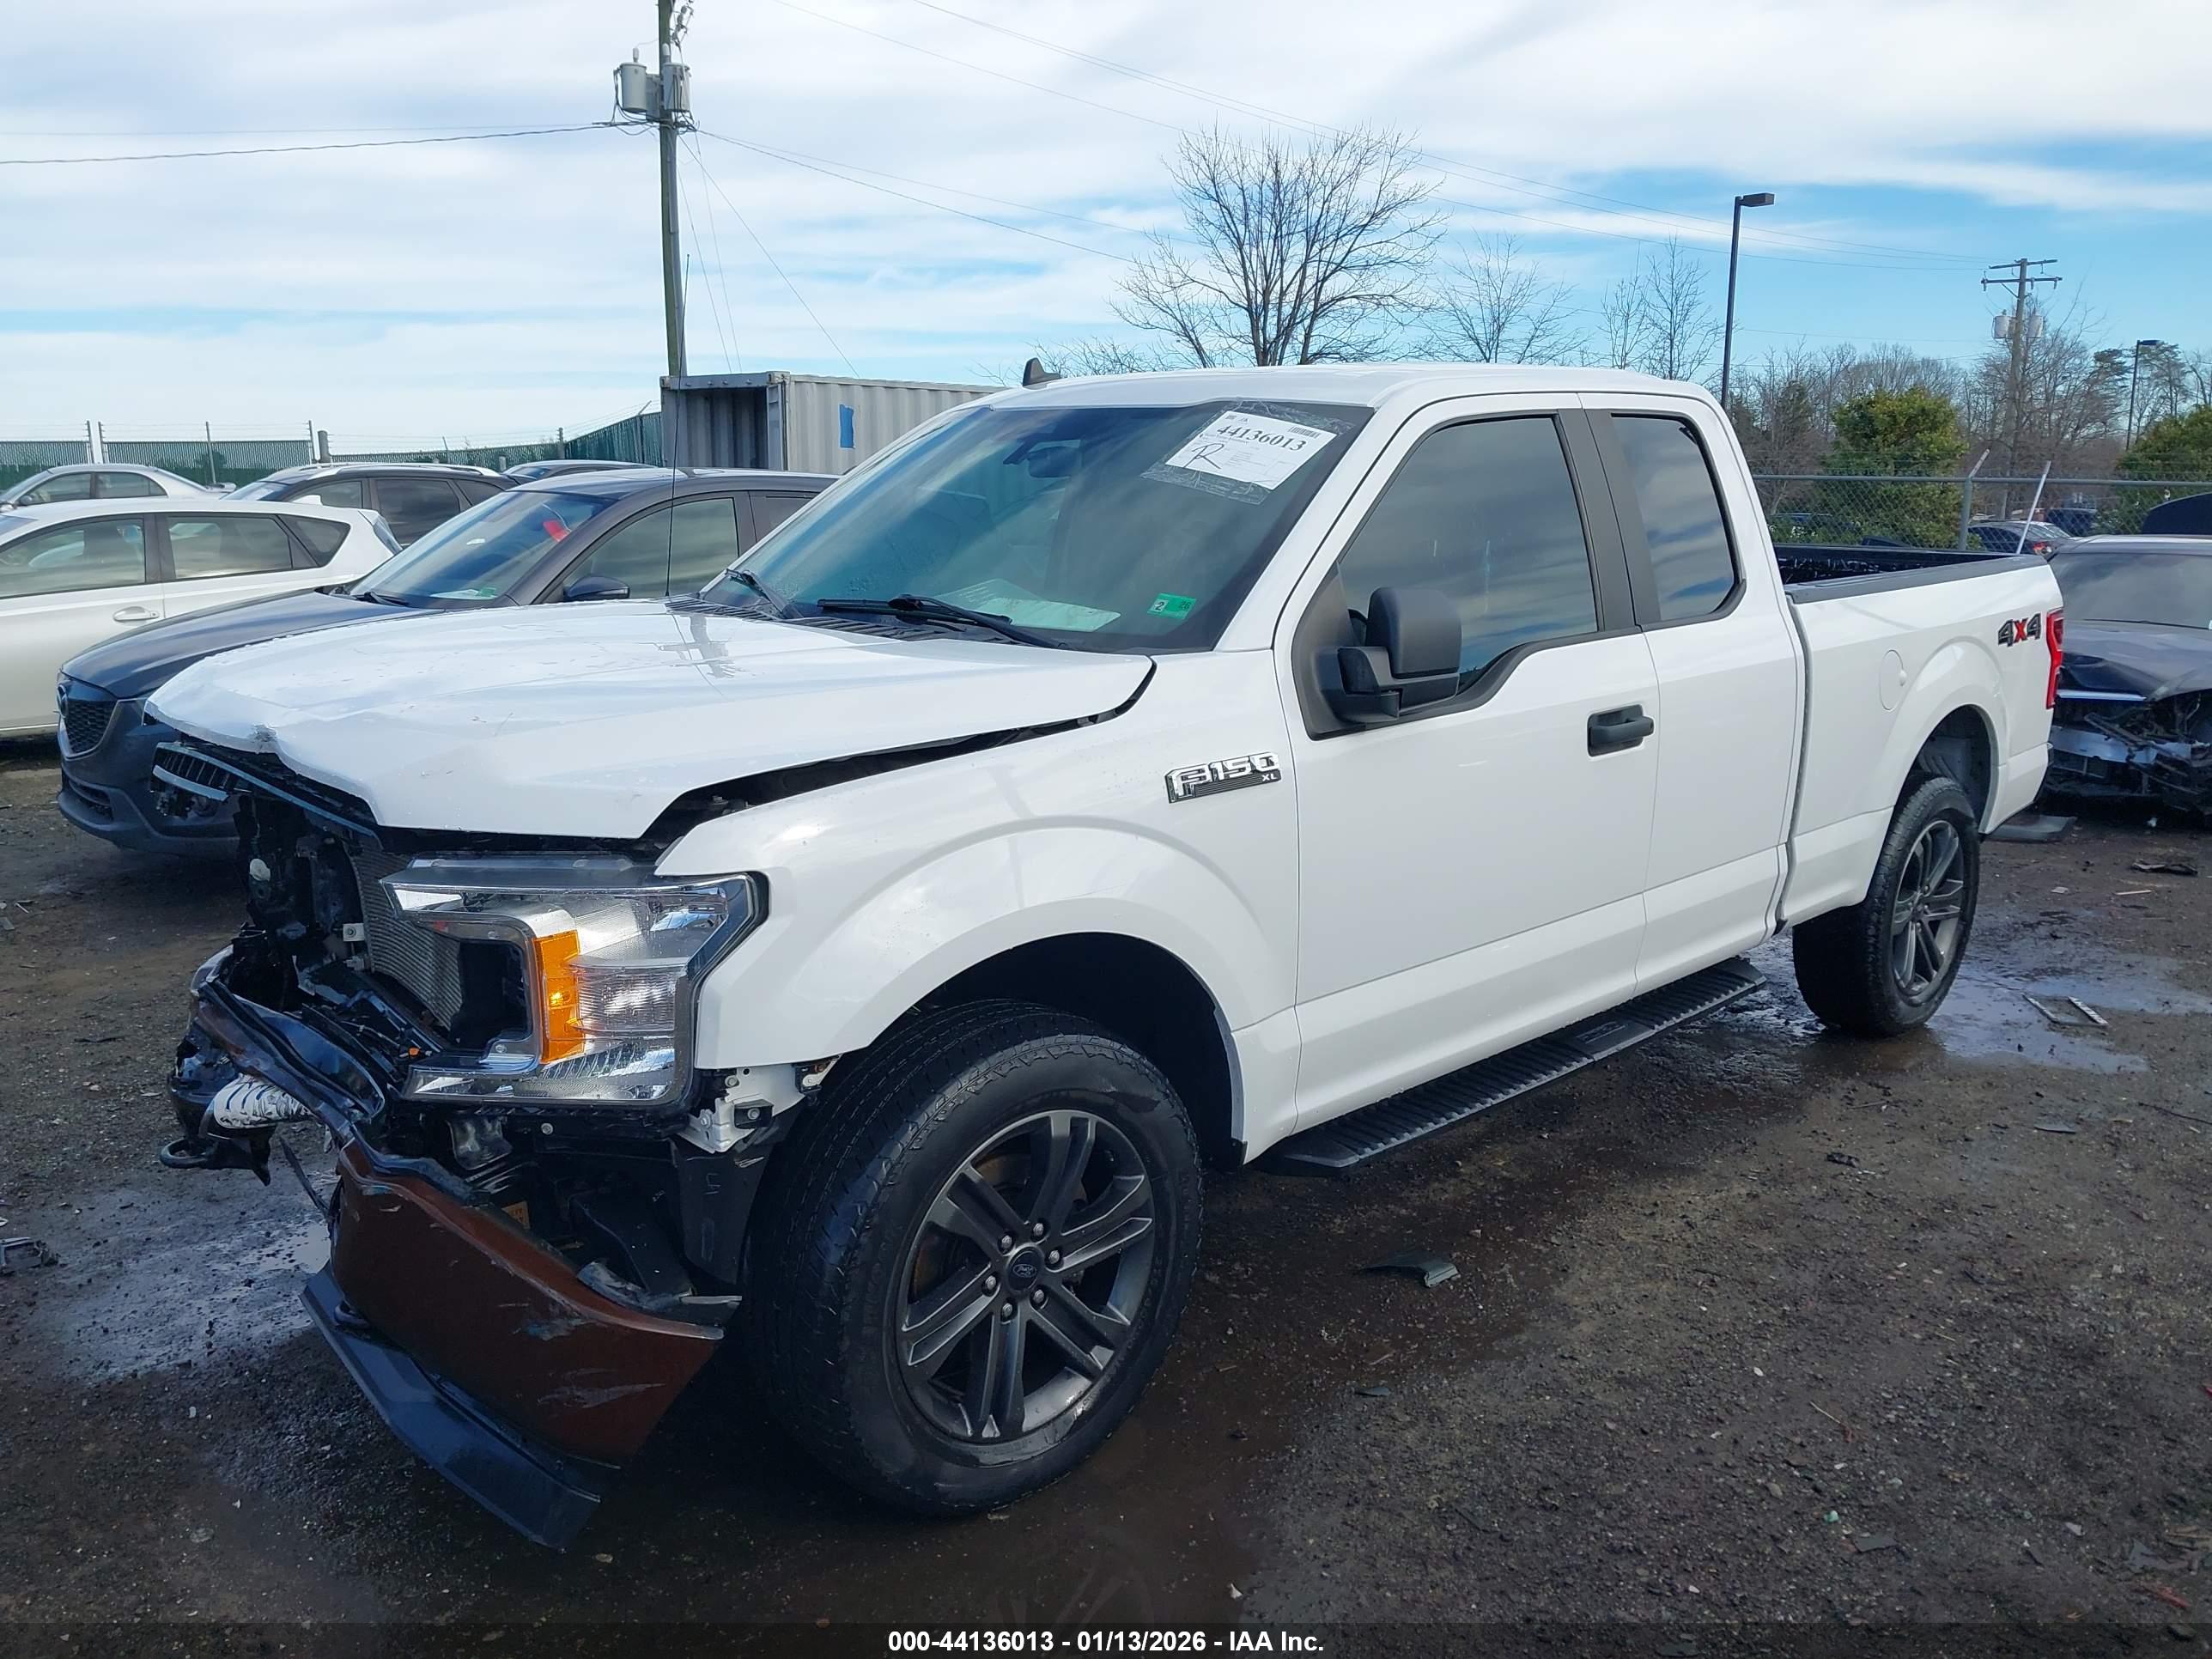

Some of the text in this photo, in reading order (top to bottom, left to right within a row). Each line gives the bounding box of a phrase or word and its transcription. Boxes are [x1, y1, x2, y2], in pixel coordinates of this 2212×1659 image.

[1217, 425, 1308, 452] 44136013
[1155, 601, 1165, 611] 2
[1261, 773, 1279, 782] XL
